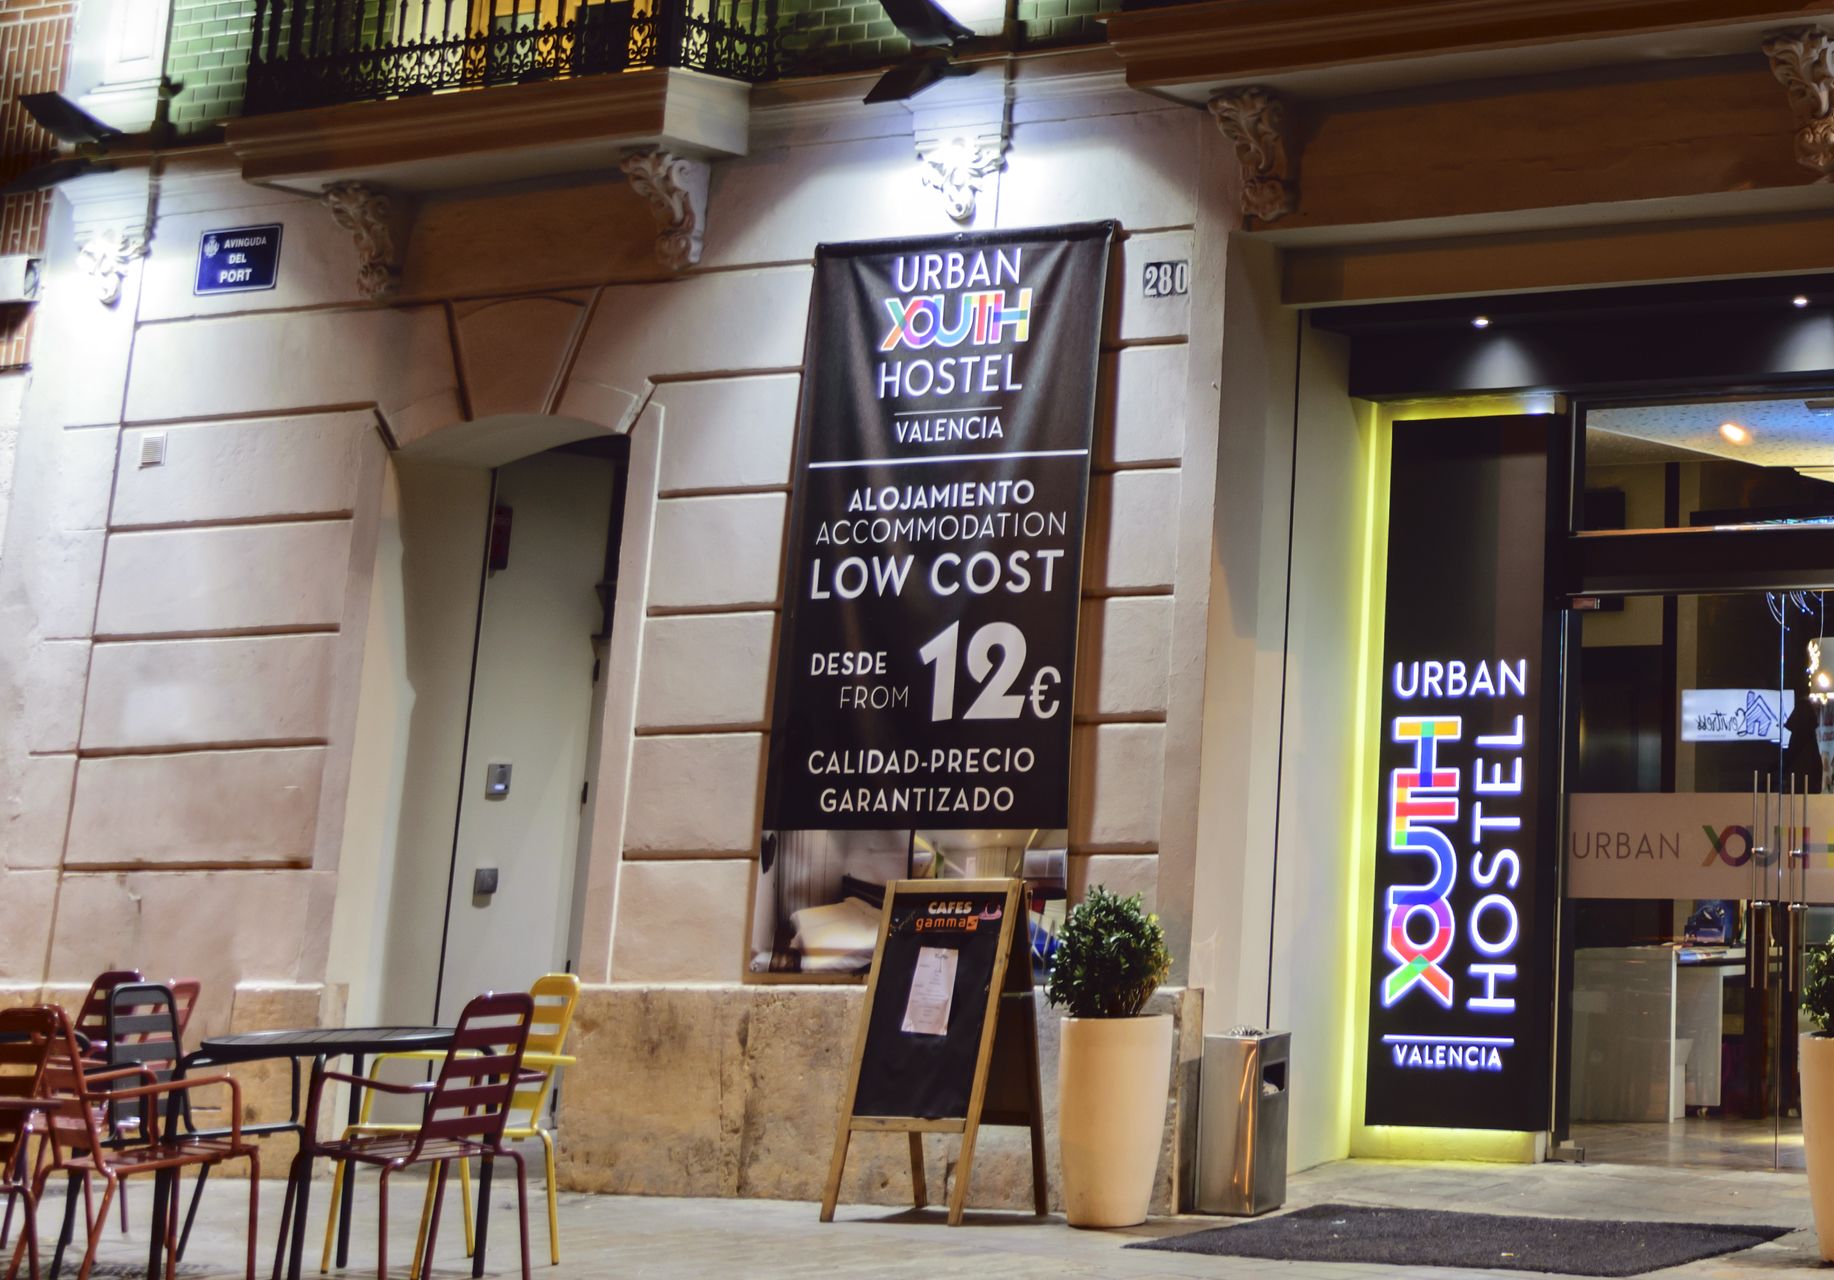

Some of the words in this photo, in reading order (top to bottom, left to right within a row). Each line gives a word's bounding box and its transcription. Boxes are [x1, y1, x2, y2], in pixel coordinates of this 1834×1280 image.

[224, 236, 267, 249] AVINGUDA
[228, 253, 247, 264] DEL
[898, 249, 1022, 293] URBAN
[219, 268, 252, 283] PORT
[1144, 263, 1188, 296] 280
[880, 288, 1032, 352] YOUTH
[878, 354, 1023, 399] HOSTEL
[897, 415, 1004, 444] VALENCIA
[849, 479, 1035, 512] ALOJAMIENTO
[816, 511, 1066, 546] ACCOMMODATION
[811, 554, 915, 600] LOW
[930, 549, 1064, 596] COST
[811, 652, 887, 677] DESDE
[1394, 659, 1526, 697] URBAN
[838, 685, 909, 711] FROM
[808, 748, 1035, 775] CALIDAD-PRECIO
[820, 787, 1014, 813] GARANTIZADO
[1572, 832, 1680, 860] URBAN
[1382, 716, 1462, 1006] YOUTH
[1467, 714, 1524, 1013] HOSTEL
[928, 901, 972, 915] CAFES
[1394, 1042, 1502, 1068] VALENCIA
